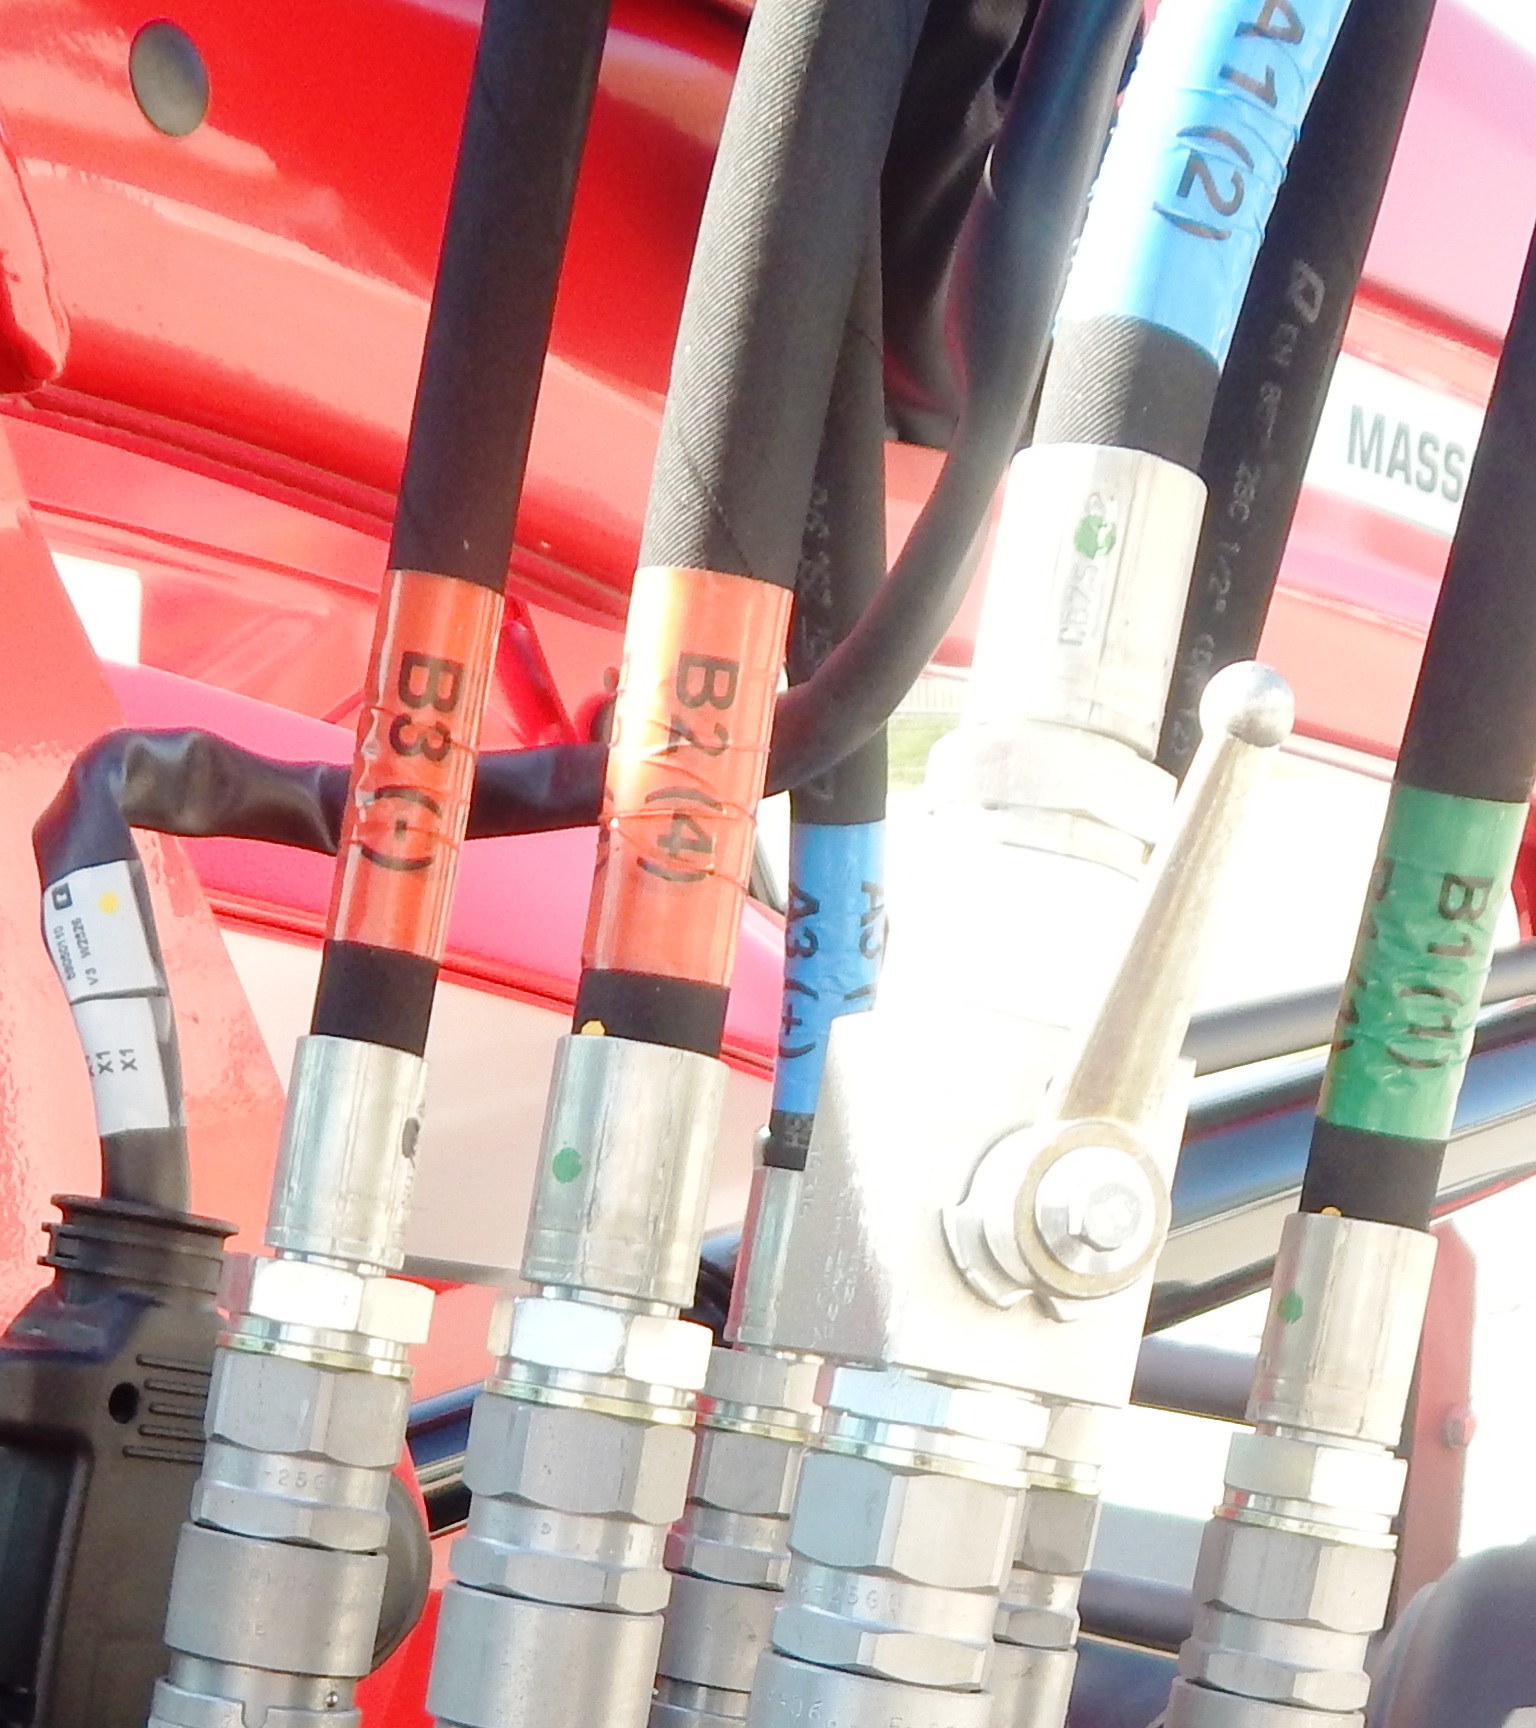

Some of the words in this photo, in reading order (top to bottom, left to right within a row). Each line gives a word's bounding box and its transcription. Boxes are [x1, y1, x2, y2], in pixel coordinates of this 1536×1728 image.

[1219, 0, 1306, 108] A1
[1151, 125, 1255, 241] (2)
[1346, 403, 1466, 504] MASS
[389, 651, 465, 762] B3
[636, 786, 724, 883] (4)
[1427, 873, 1493, 957] B1
